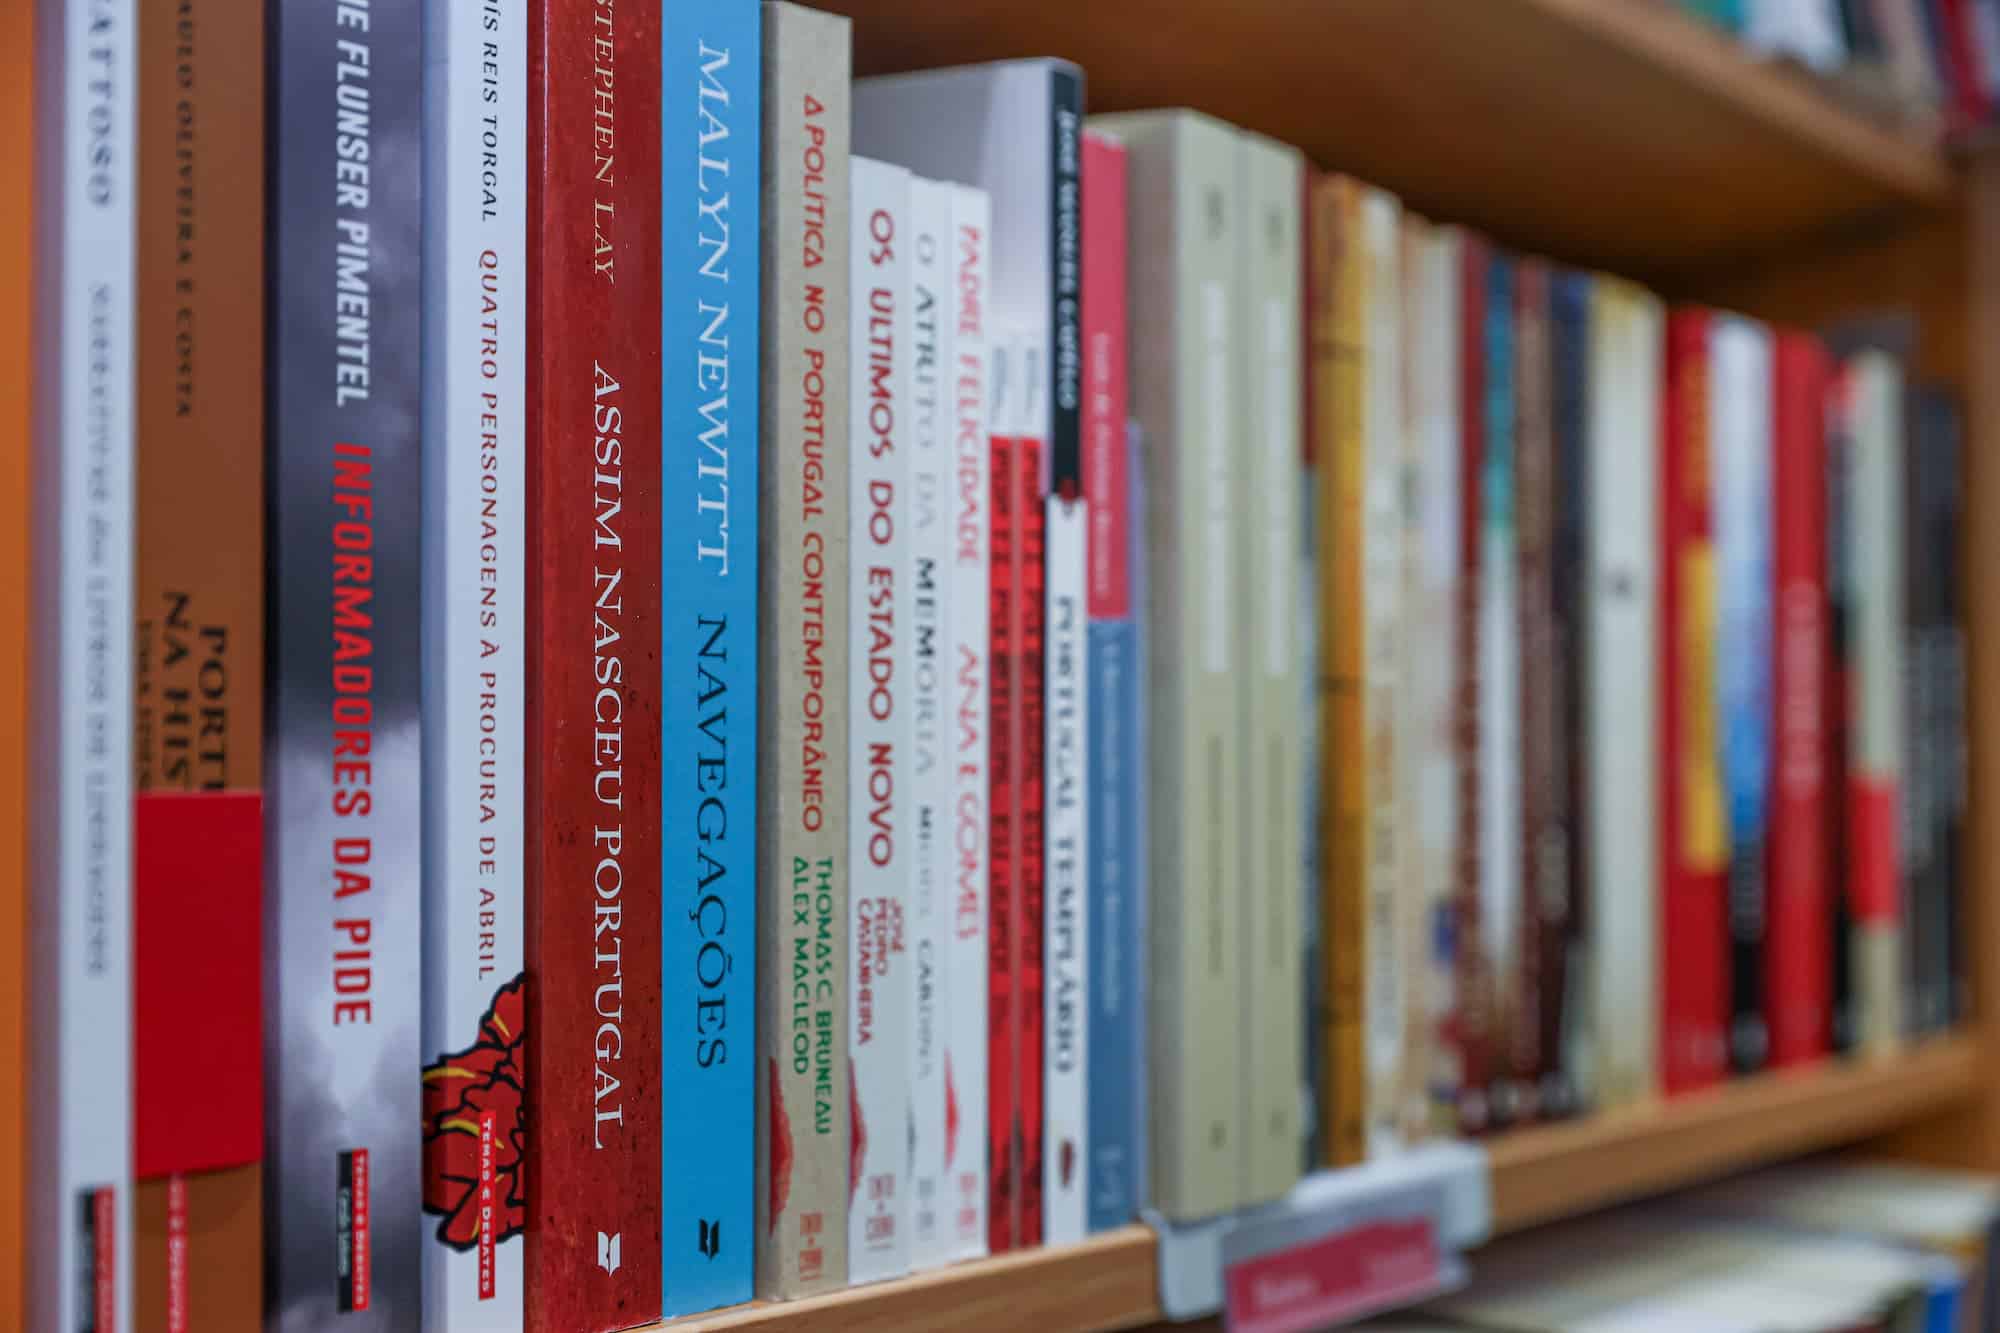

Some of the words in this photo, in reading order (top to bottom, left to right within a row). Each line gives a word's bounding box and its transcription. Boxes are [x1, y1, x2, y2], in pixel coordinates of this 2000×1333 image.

[482, 41, 498, 104] REIS
[483, 0, 501, 32] ÍS
[86, 0, 113, 209] ATTOSO
[335, 39, 370, 208] FLUNSER
[481, 115, 498, 223] TORGAL
[698, 37, 730, 284] MALYN
[803, 94, 825, 117] A
[593, 198, 615, 285] LAY
[802, 123, 830, 269] POLÍTICA
[868, 208, 894, 267] OS
[335, 217, 370, 408] PIMENTEL
[479, 248, 498, 380] QUATRO
[802, 284, 825, 334] NO
[957, 224, 981, 338] PADRE
[593, 359, 623, 553] ASSIM
[697, 296, 730, 577] NEWITT
[802, 348, 825, 521] PORTUGAL
[956, 353, 981, 570] FELICIDADE
[479, 391, 498, 629] PERSONAGENS
[867, 479, 894, 546] DO
[162, 592, 191, 668] NA
[331, 441, 372, 818] INFORMADORES
[479, 639, 500, 659] À
[593, 566, 623, 811] NASCEU
[801, 531, 828, 834] CONTEMPORÂNEO
[867, 565, 894, 723] ESTADO
[161, 687, 191, 792] HIS
[478, 671, 497, 824] PROCURA
[1055, 593, 1078, 811] PORTUGAL
[332, 836, 372, 901] DA
[478, 836, 496, 876] DE
[688, 614, 733, 1069] NAVEGAÇÕES
[867, 741, 894, 869] NOVO
[478, 887, 496, 982] ABRIL
[792, 855, 810, 927] ALEX
[815, 855, 833, 975] THOMAS
[332, 918, 372, 1027] PIDE
[593, 823, 623, 1150] PORTUGAL
[792, 937, 810, 1076] MACLEOD
[857, 897, 873, 1047] CASTANHEIRA
[814, 1010, 833, 1136] BRUNEAU
